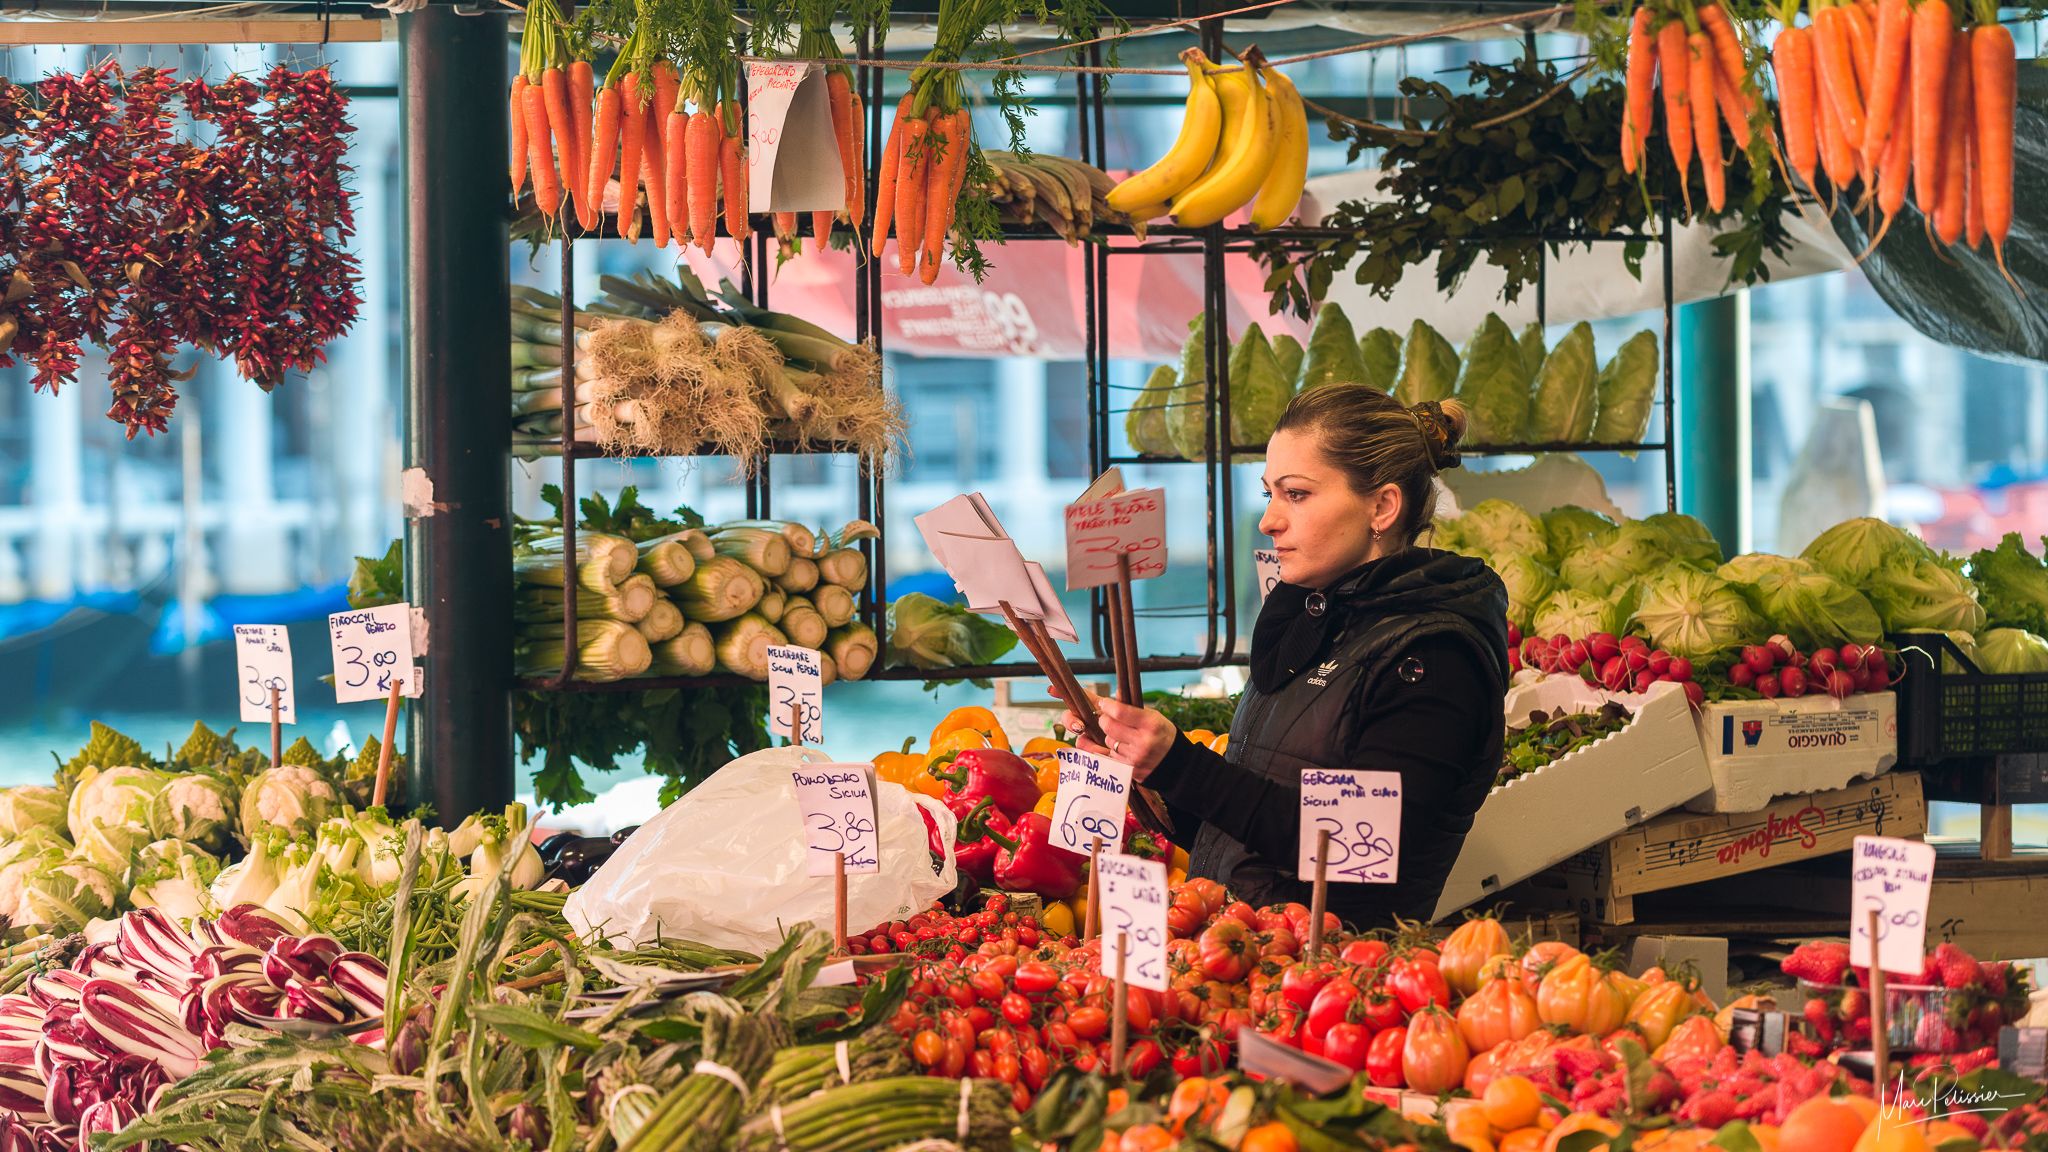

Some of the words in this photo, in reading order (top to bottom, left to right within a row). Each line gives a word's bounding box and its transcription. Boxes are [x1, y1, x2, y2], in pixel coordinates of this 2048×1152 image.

[1307, 677, 1327, 687] adidas
[1788, 731, 1847, 749] QUAGGIO
[1716, 806, 1825, 865] Sinfonia
